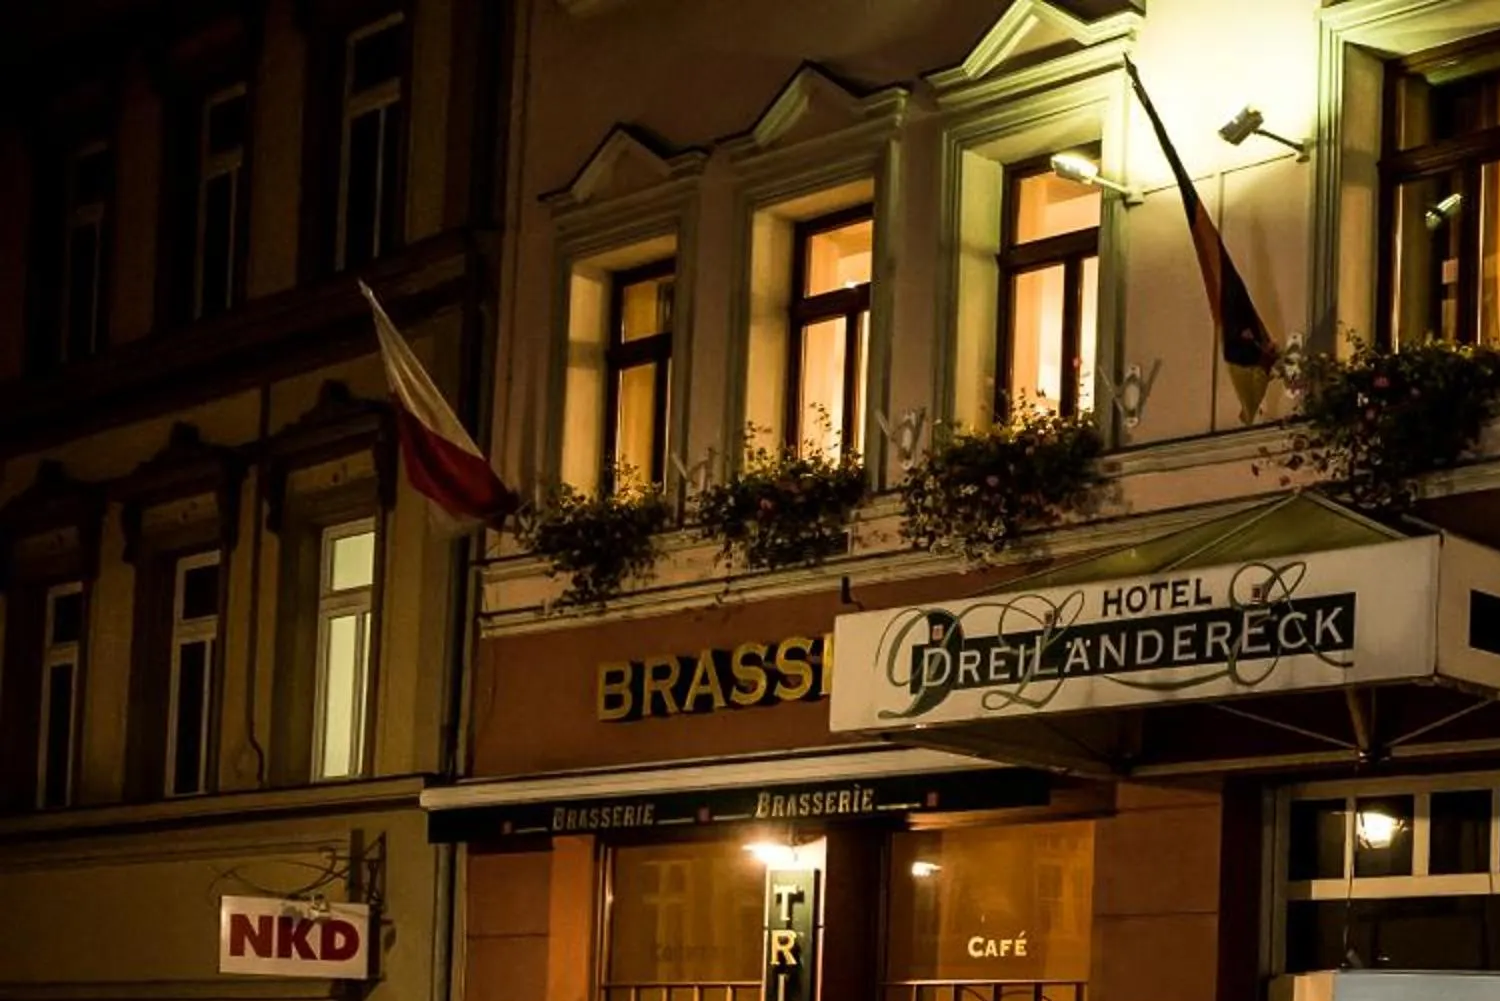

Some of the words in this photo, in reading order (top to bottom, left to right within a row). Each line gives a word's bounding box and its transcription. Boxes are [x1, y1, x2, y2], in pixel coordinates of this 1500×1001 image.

[1102, 578, 1213, 617] HOTEL
[922, 605, 1345, 689] DREILÄNDERECK
[552, 803, 655, 832] BRASSERIE
[755, 784, 877, 819] BRASSERIE
[229, 913, 360, 961] NKD
[967, 929, 1029, 960] CAFÉ
